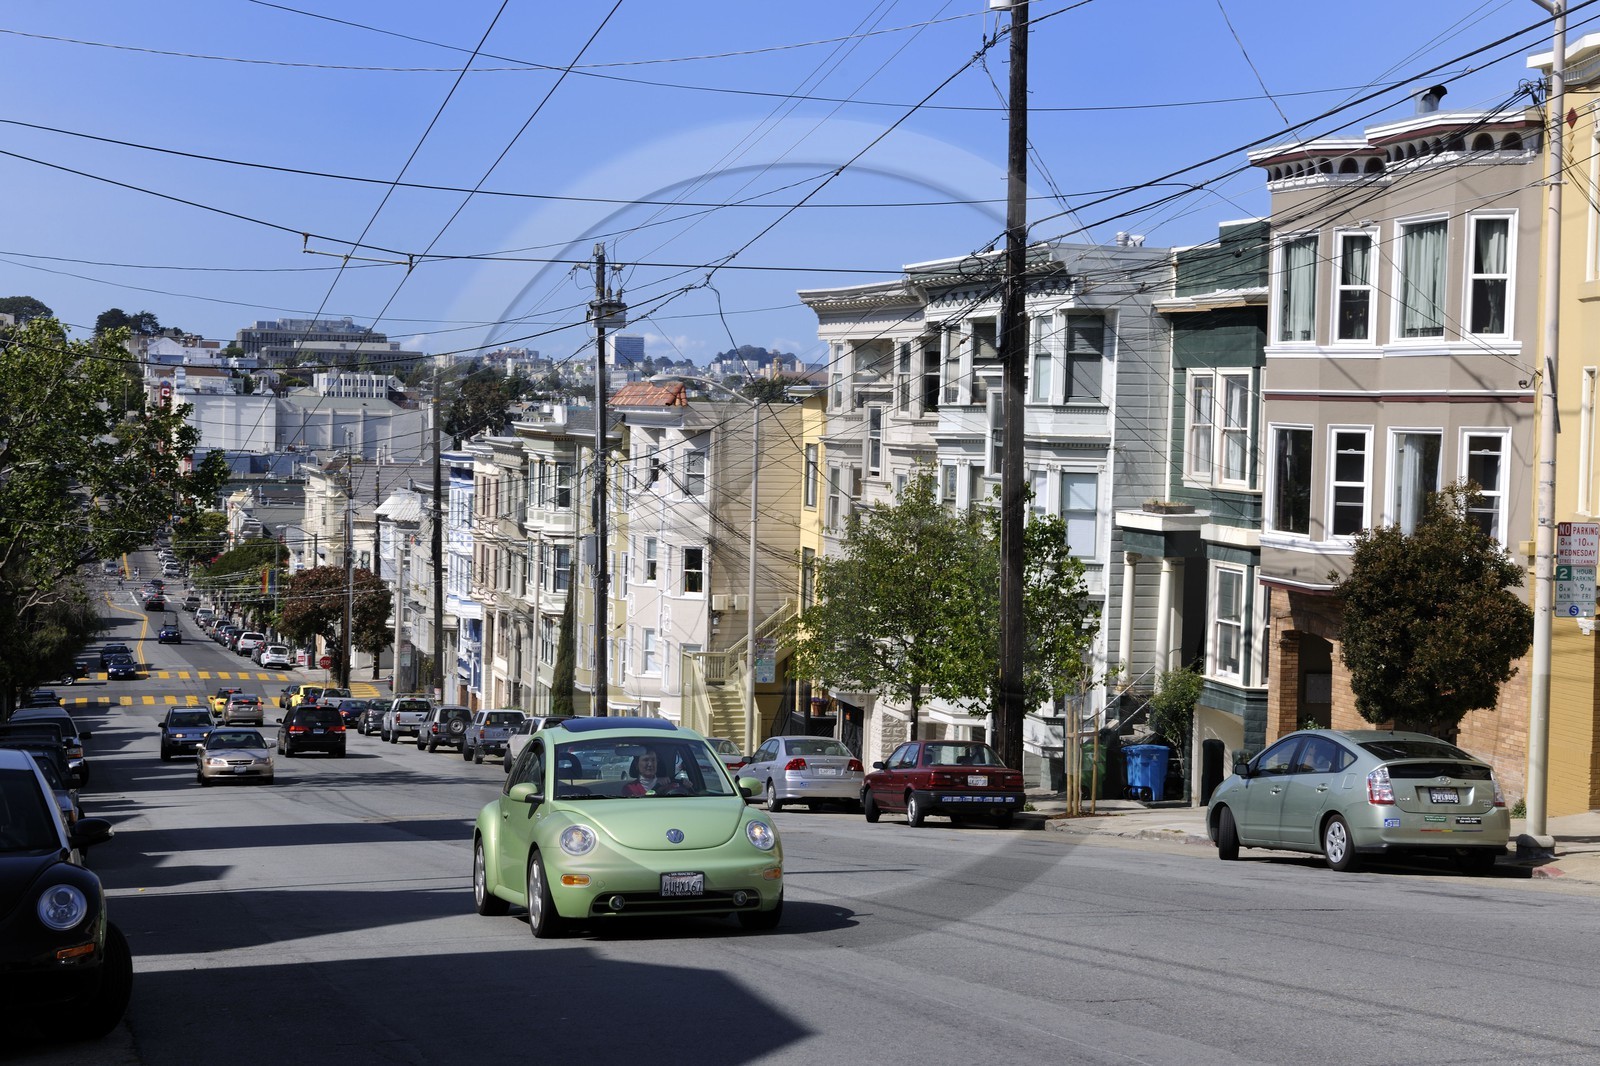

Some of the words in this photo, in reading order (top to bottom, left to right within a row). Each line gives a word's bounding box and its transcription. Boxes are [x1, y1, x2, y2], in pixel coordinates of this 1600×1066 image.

[1559, 524, 1571, 536] NO
[1572, 526, 1599, 536] PARKING
[1559, 549, 1596, 557] WEDNESDAY
[1559, 567, 1568, 579] 2
[1571, 606, 1578, 615] S
[663, 880, 702, 892] 4UHX167
